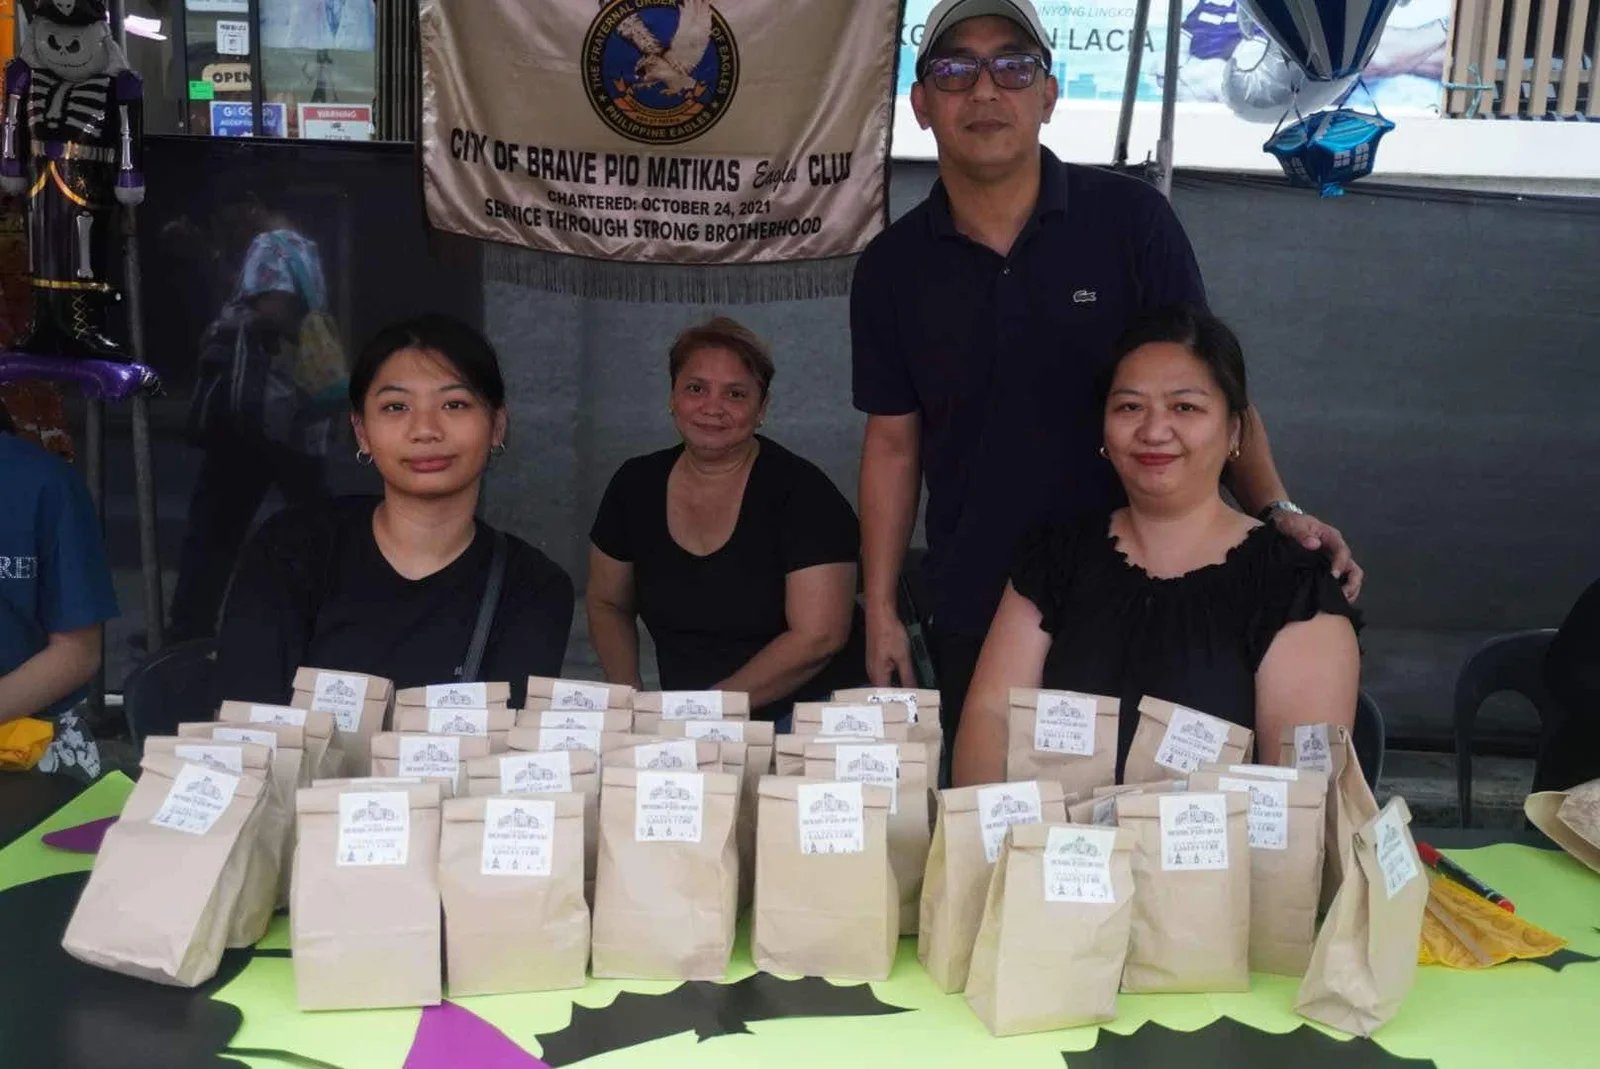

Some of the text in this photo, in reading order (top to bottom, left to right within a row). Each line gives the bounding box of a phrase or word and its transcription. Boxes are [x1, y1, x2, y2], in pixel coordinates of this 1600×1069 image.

[590, 3, 635, 62] FRATERNAL
[591, 65, 601, 87] THE
[718, 45, 732, 95] EAGLES
[605, 105, 712, 138] PHILIPPINE EAGLES
[494, 140, 519, 173] OF
[527, 146, 597, 185] BRAVE
[605, 153, 640, 186] PIO
[647, 156, 740, 192] MATIKAS
[548, 190, 771, 218] CHARTERED: OCTOBER 24, 2021
[546, 210, 628, 238] THROUGH
[633, 219, 700, 241] STRONG
[705, 217, 822, 243] BROTHERHOOD
